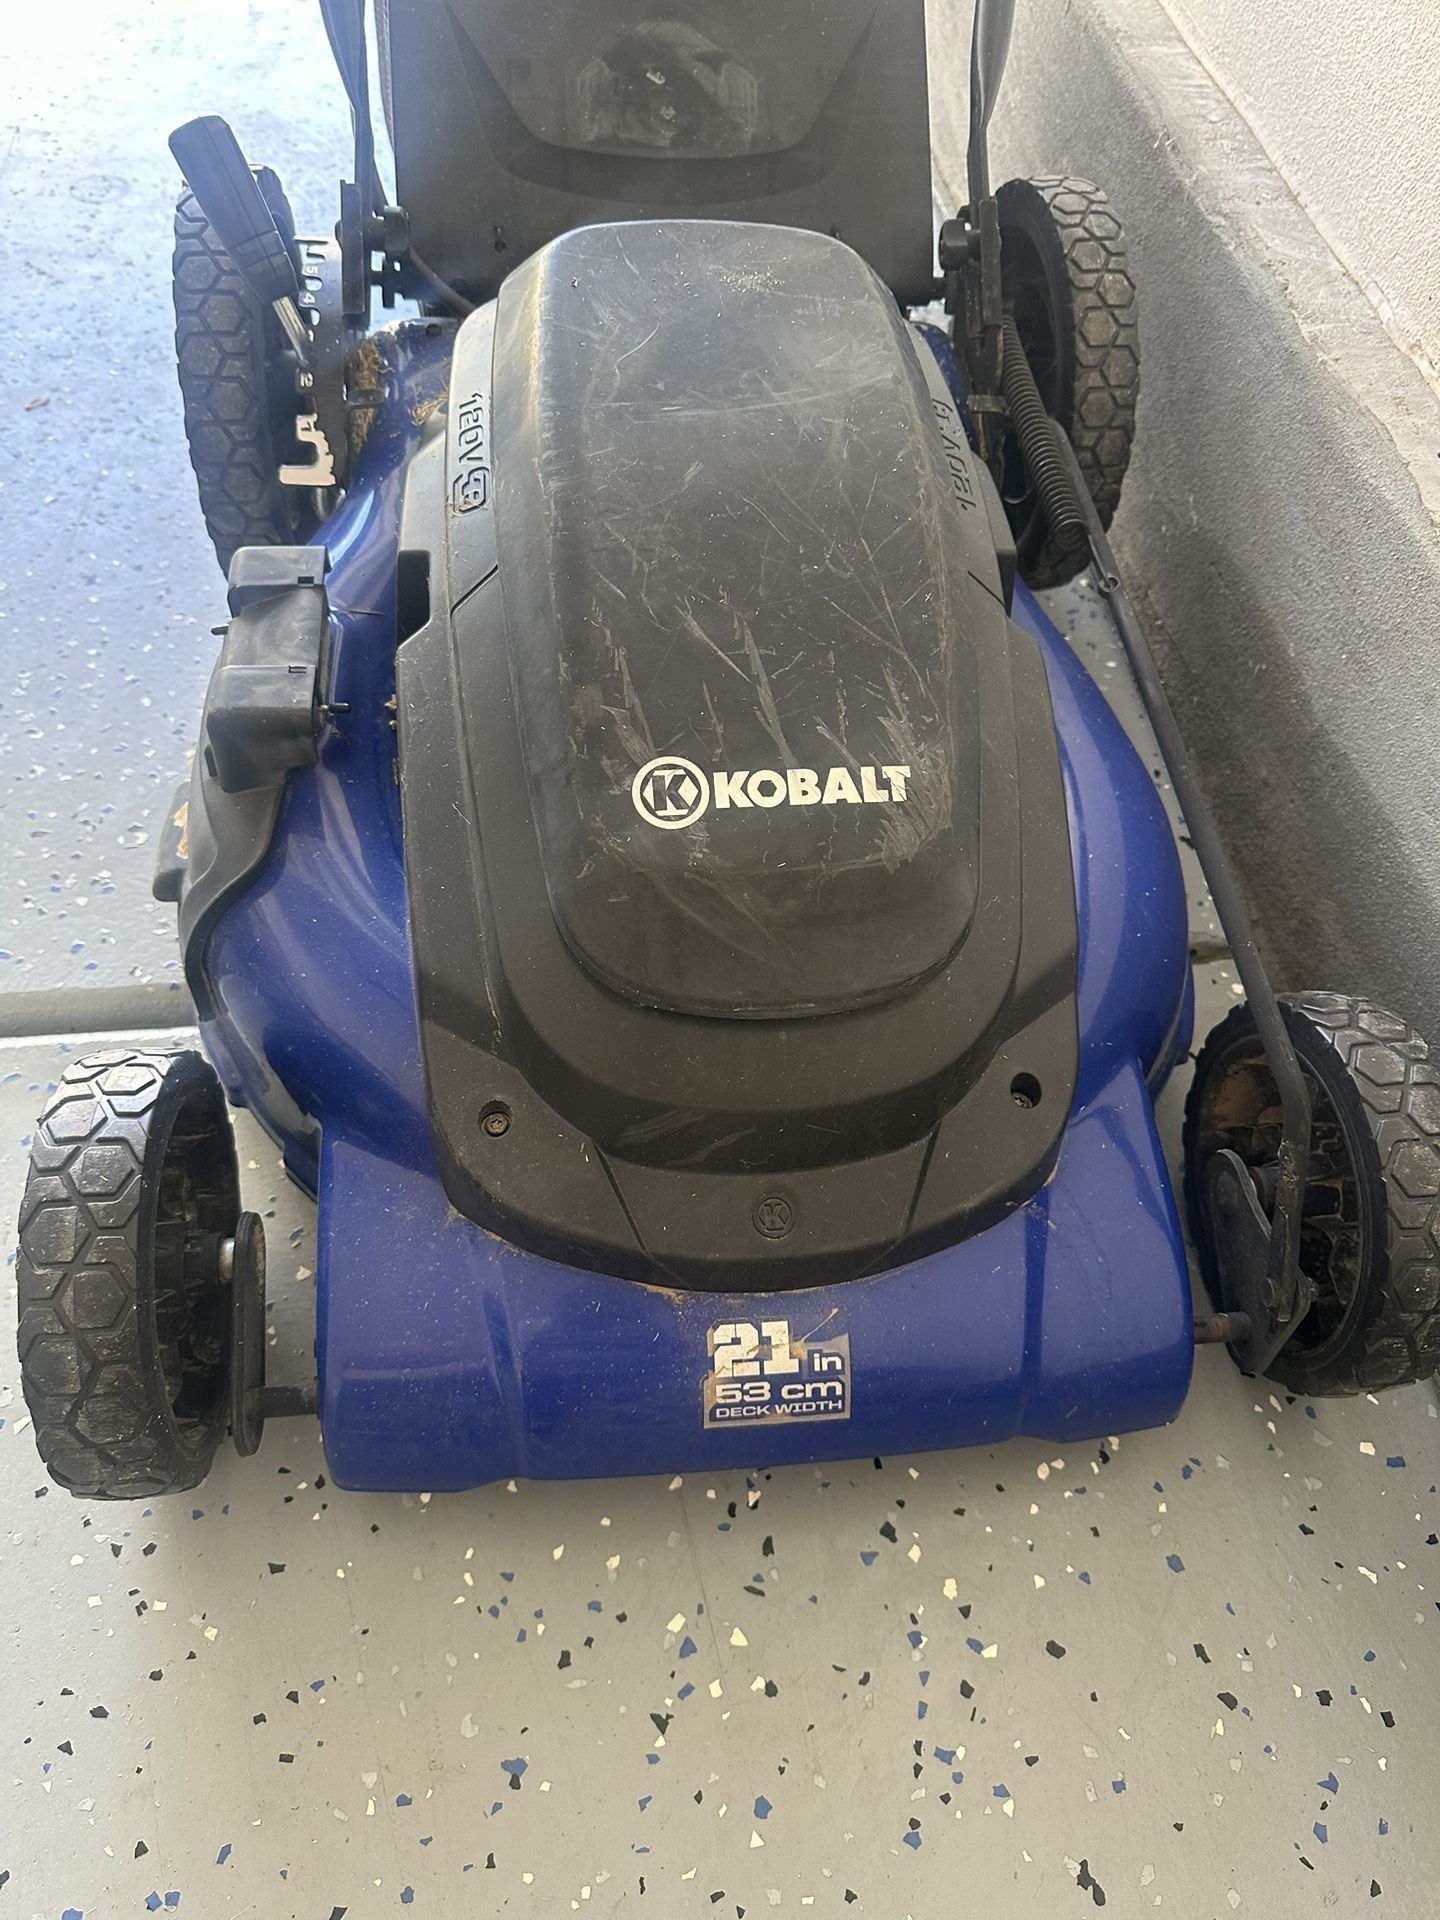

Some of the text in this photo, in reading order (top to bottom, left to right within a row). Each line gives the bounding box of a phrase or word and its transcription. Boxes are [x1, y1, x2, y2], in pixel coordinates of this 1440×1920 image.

[303, 292, 316, 304] 4
[299, 372, 314, 387] 2
[458, 392, 484, 464] 120V
[713, 765, 911, 809] KOBALT
[712, 1320, 843, 1379] 21 in
[715, 1380, 843, 1404] 53 cm
[715, 1399, 843, 1419] DECK WIDTH
